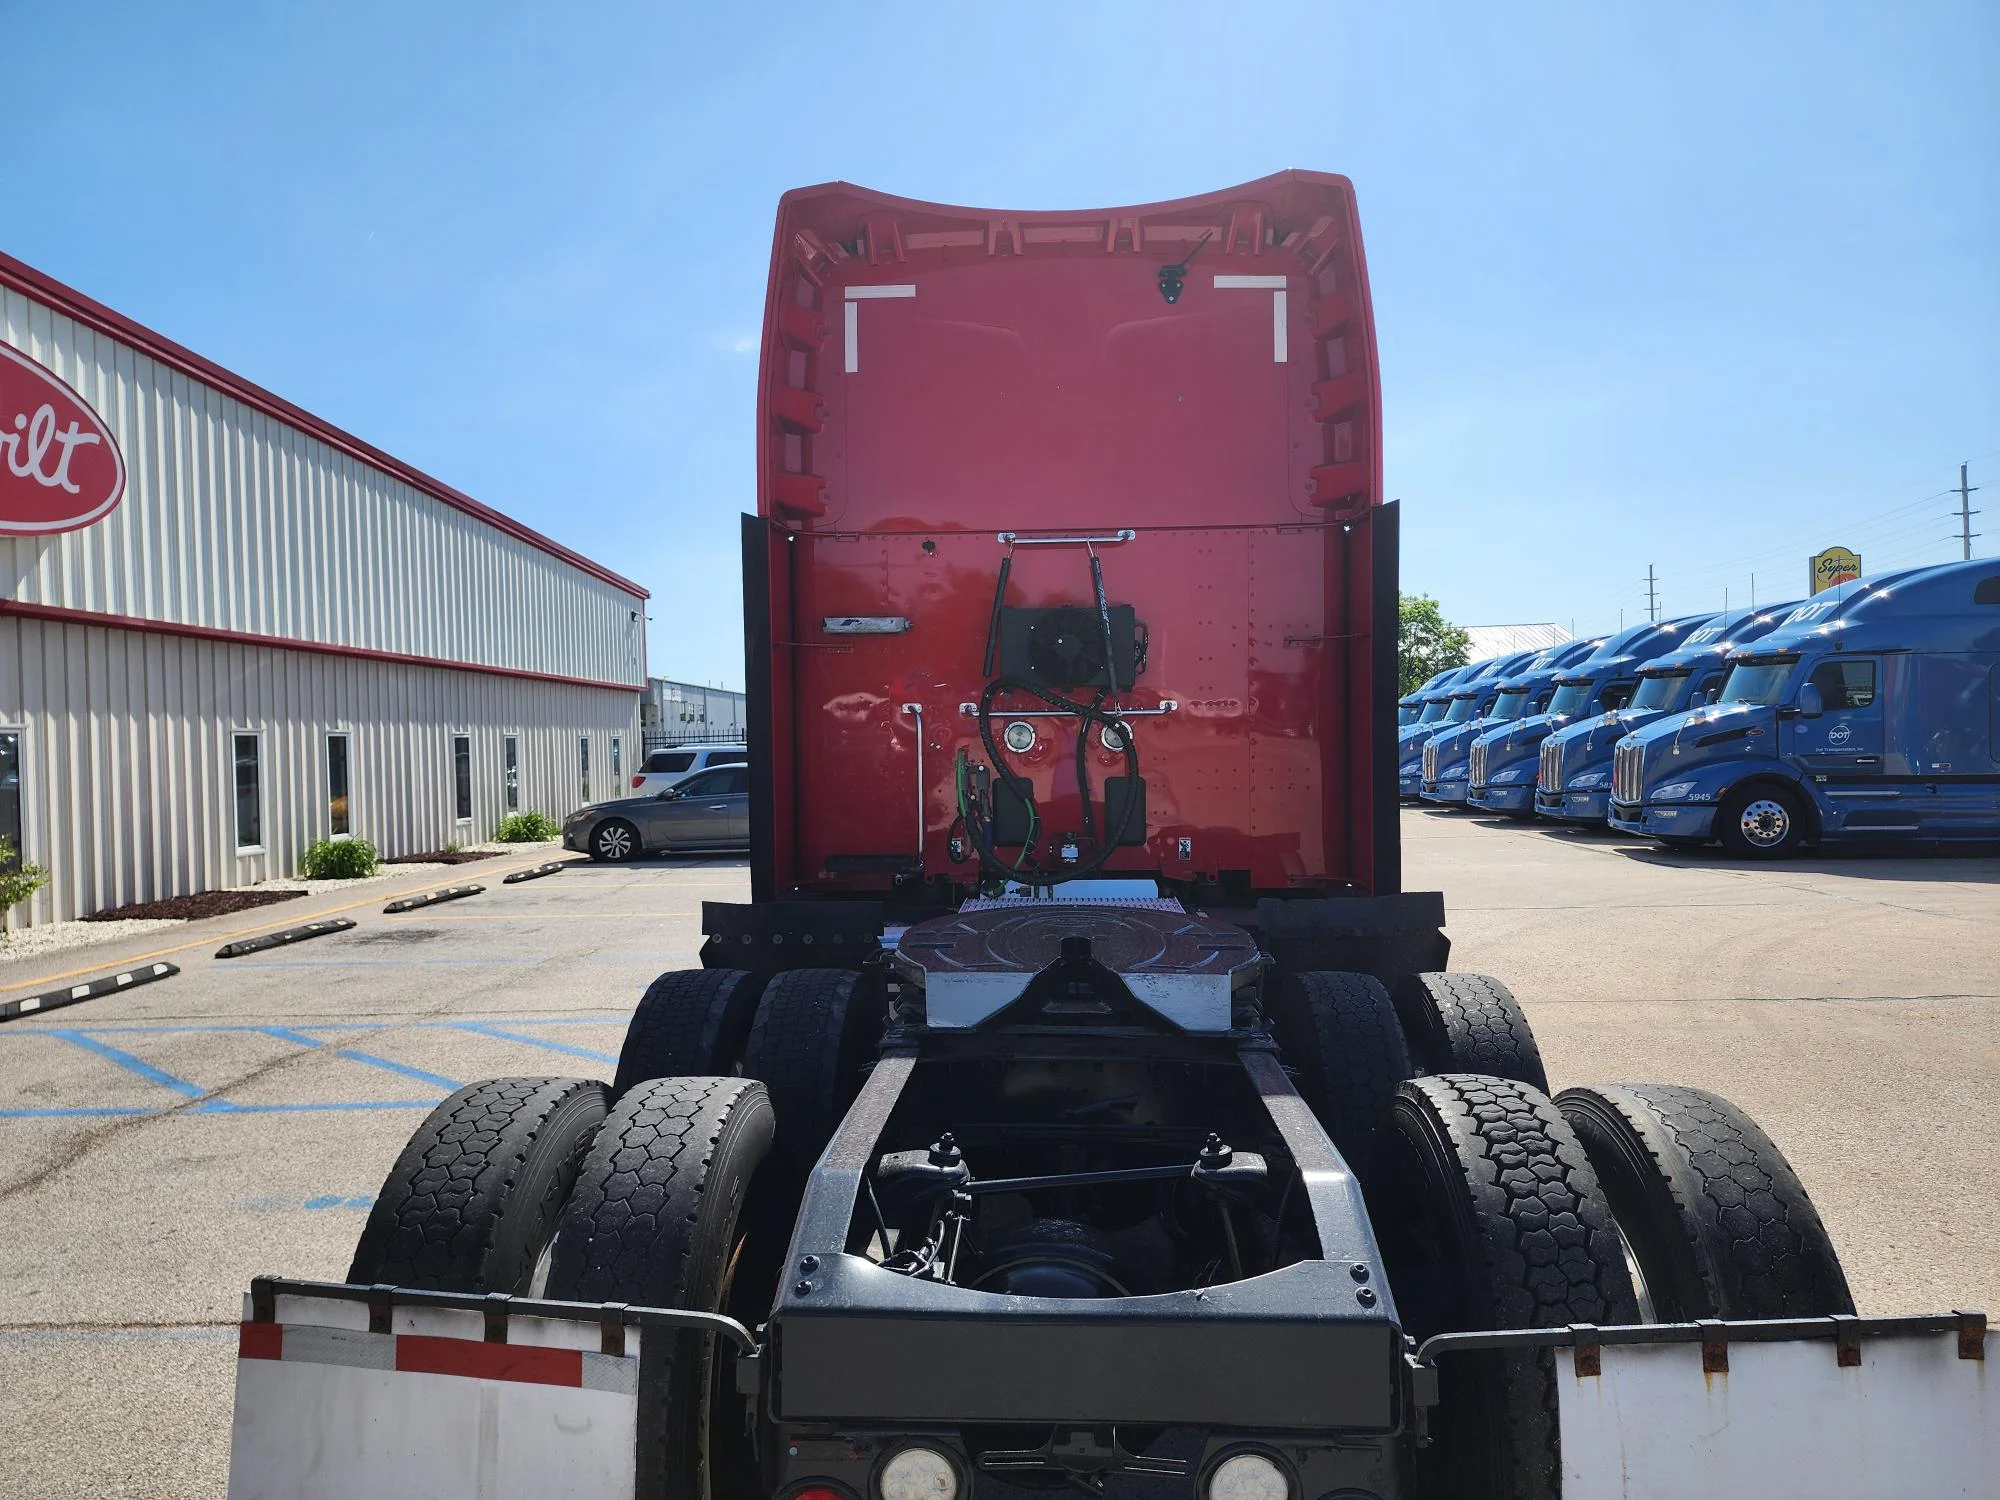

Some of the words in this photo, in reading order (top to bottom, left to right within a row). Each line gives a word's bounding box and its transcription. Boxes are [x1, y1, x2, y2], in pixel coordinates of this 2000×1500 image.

[0, 403, 100, 494] ilt
[1818, 558, 1859, 580] Super
[1783, 601, 1841, 626] DOT
[1687, 793, 1711, 801] 5945
